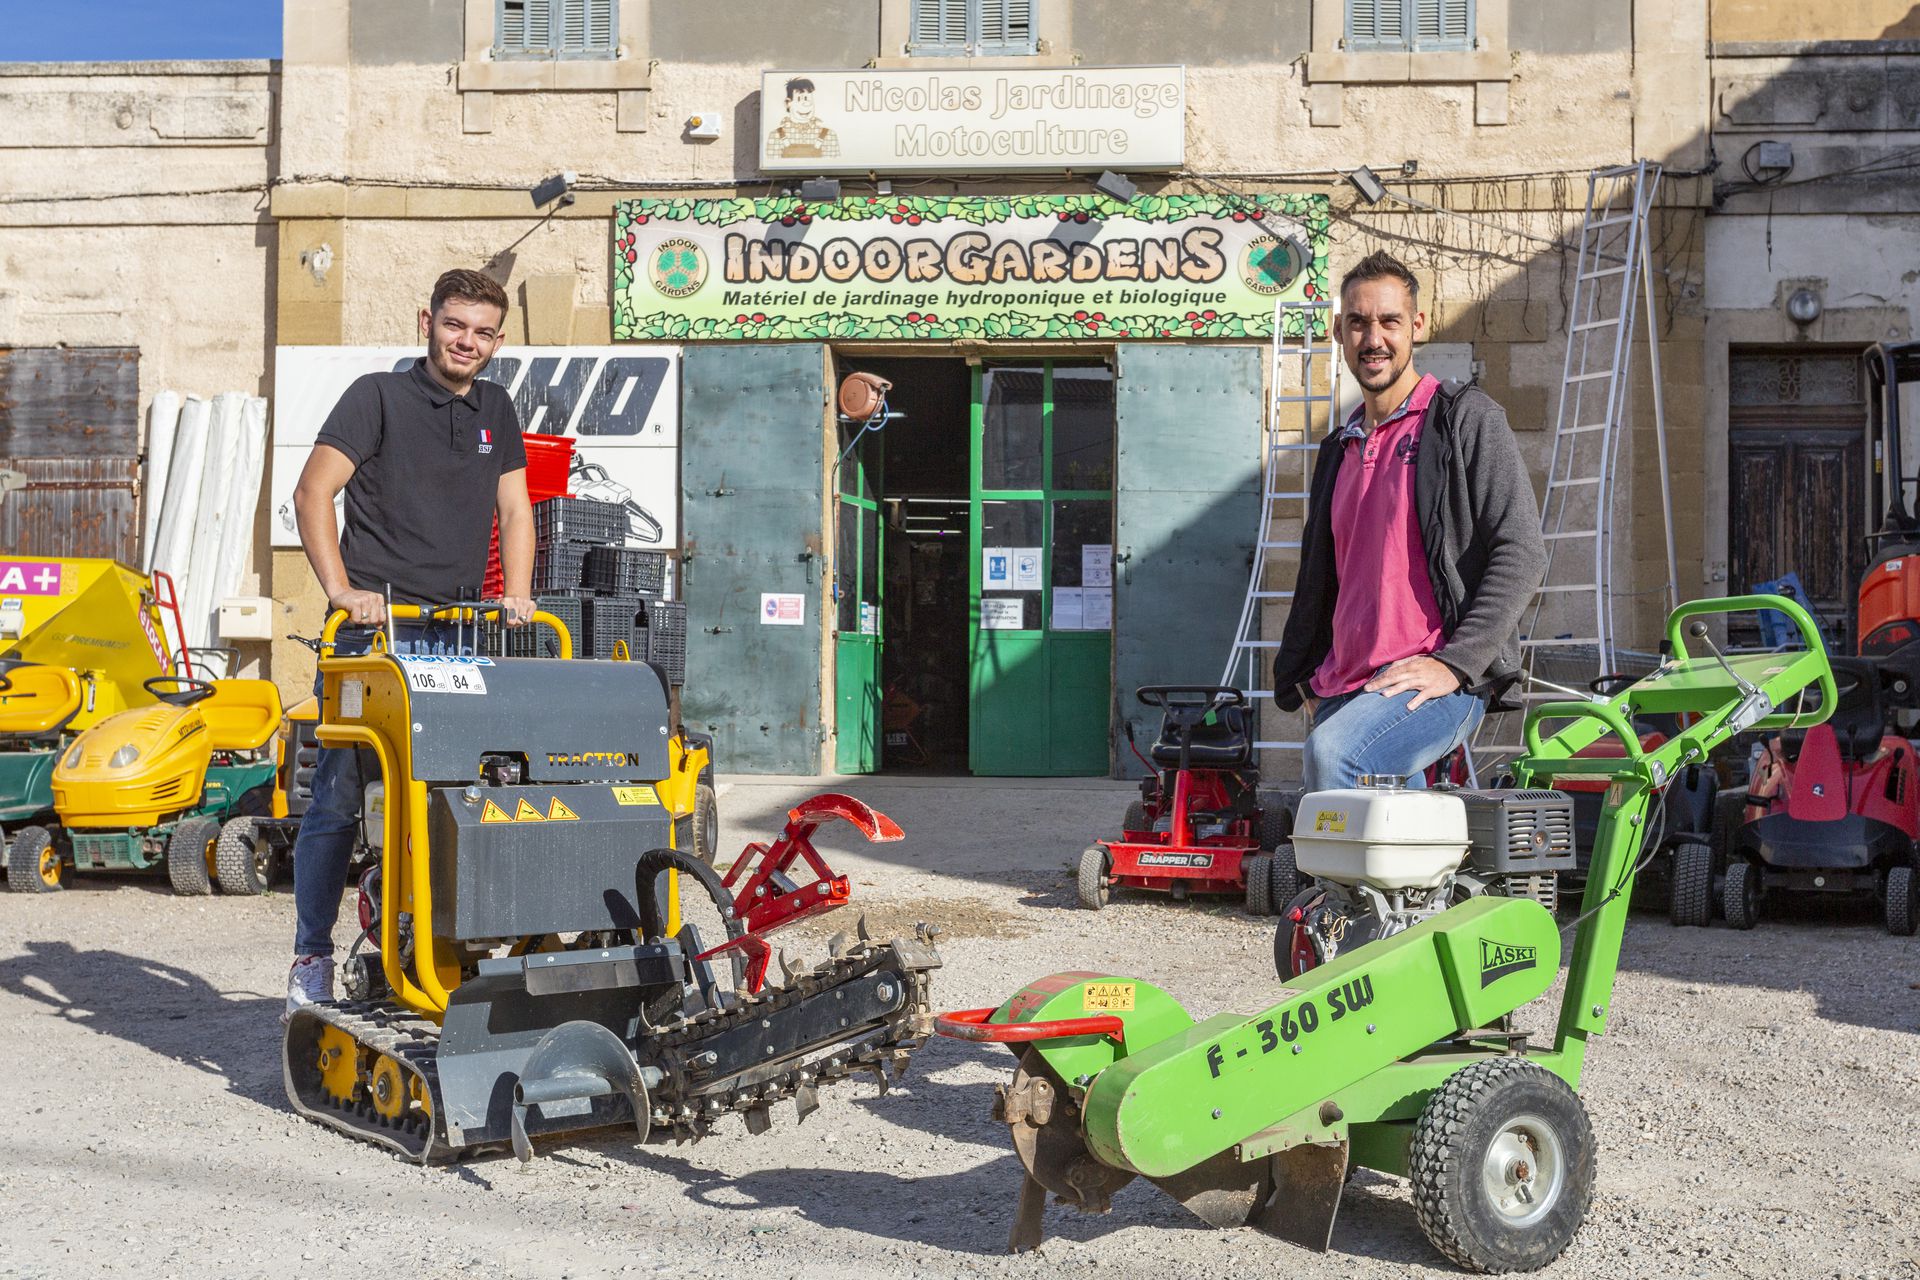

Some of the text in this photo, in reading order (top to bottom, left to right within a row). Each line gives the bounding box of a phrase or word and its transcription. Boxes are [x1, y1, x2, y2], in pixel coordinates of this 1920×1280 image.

[845, 75, 1180, 120] Nicolas Jardinage
[895, 120, 1129, 157] Motoculture
[658, 239, 698, 252] INDOOR
[1248, 235, 1290, 249] INDOOR
[655, 280, 700, 296] GARDENS
[1245, 277, 1292, 293] GARDENS
[722, 290, 1227, 308] Matériel de jardinage hydroponique et biologique
[413, 673, 436, 689] 106
[452, 675, 469, 690] 84
[545, 752, 640, 767] TRACTION
[1141, 854, 1188, 865] SNAPPER
[1482, 942, 1536, 970] LASKI
[1207, 1044, 1224, 1078] F
[1256, 1001, 1319, 1054] 360
